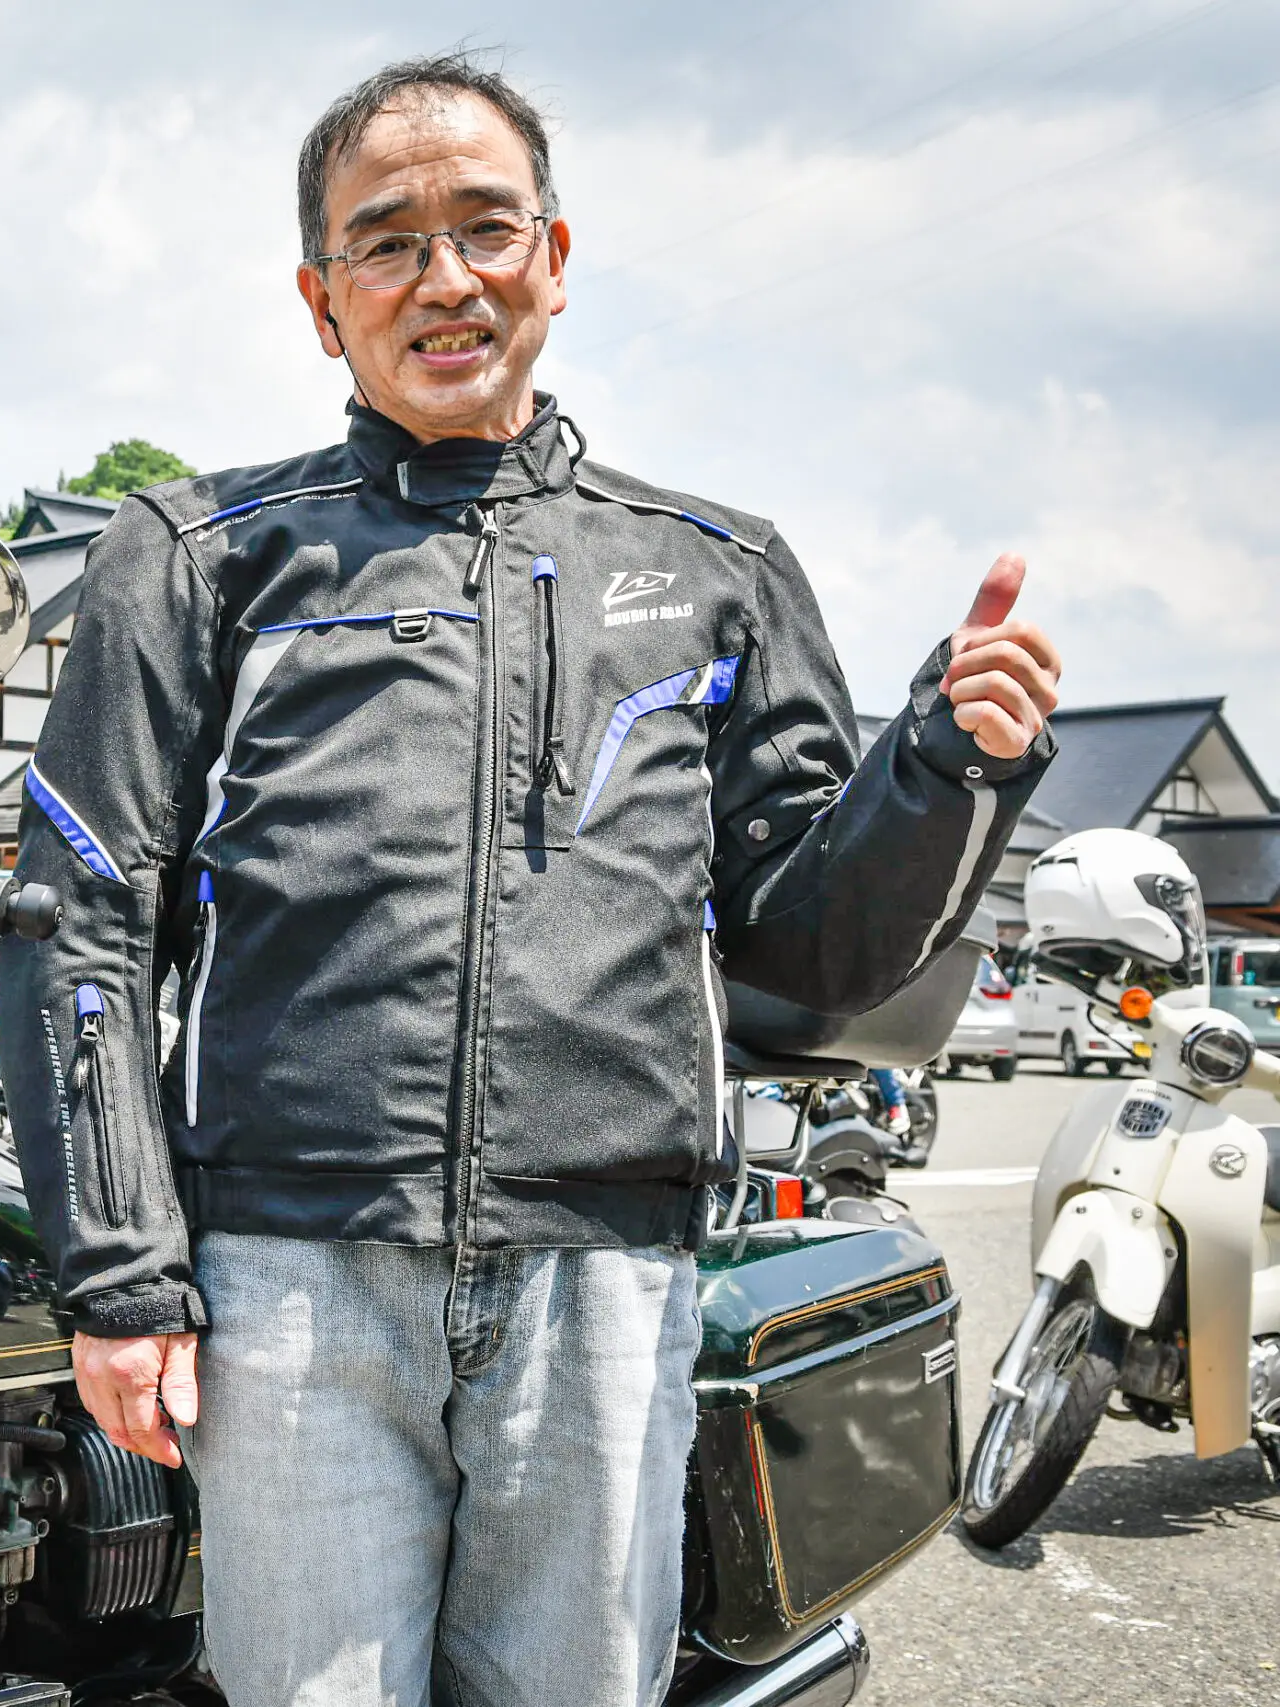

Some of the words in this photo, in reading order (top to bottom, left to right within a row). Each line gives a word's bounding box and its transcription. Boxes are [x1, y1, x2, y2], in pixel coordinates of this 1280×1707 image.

[604, 607, 649, 628] ROUGH
[659, 602, 695, 620] ROAD
[40, 1008, 67, 1097] EXPERIENCE
[60, 1101, 71, 1129] THE
[63, 1132, 79, 1223] EXCELLENCE
